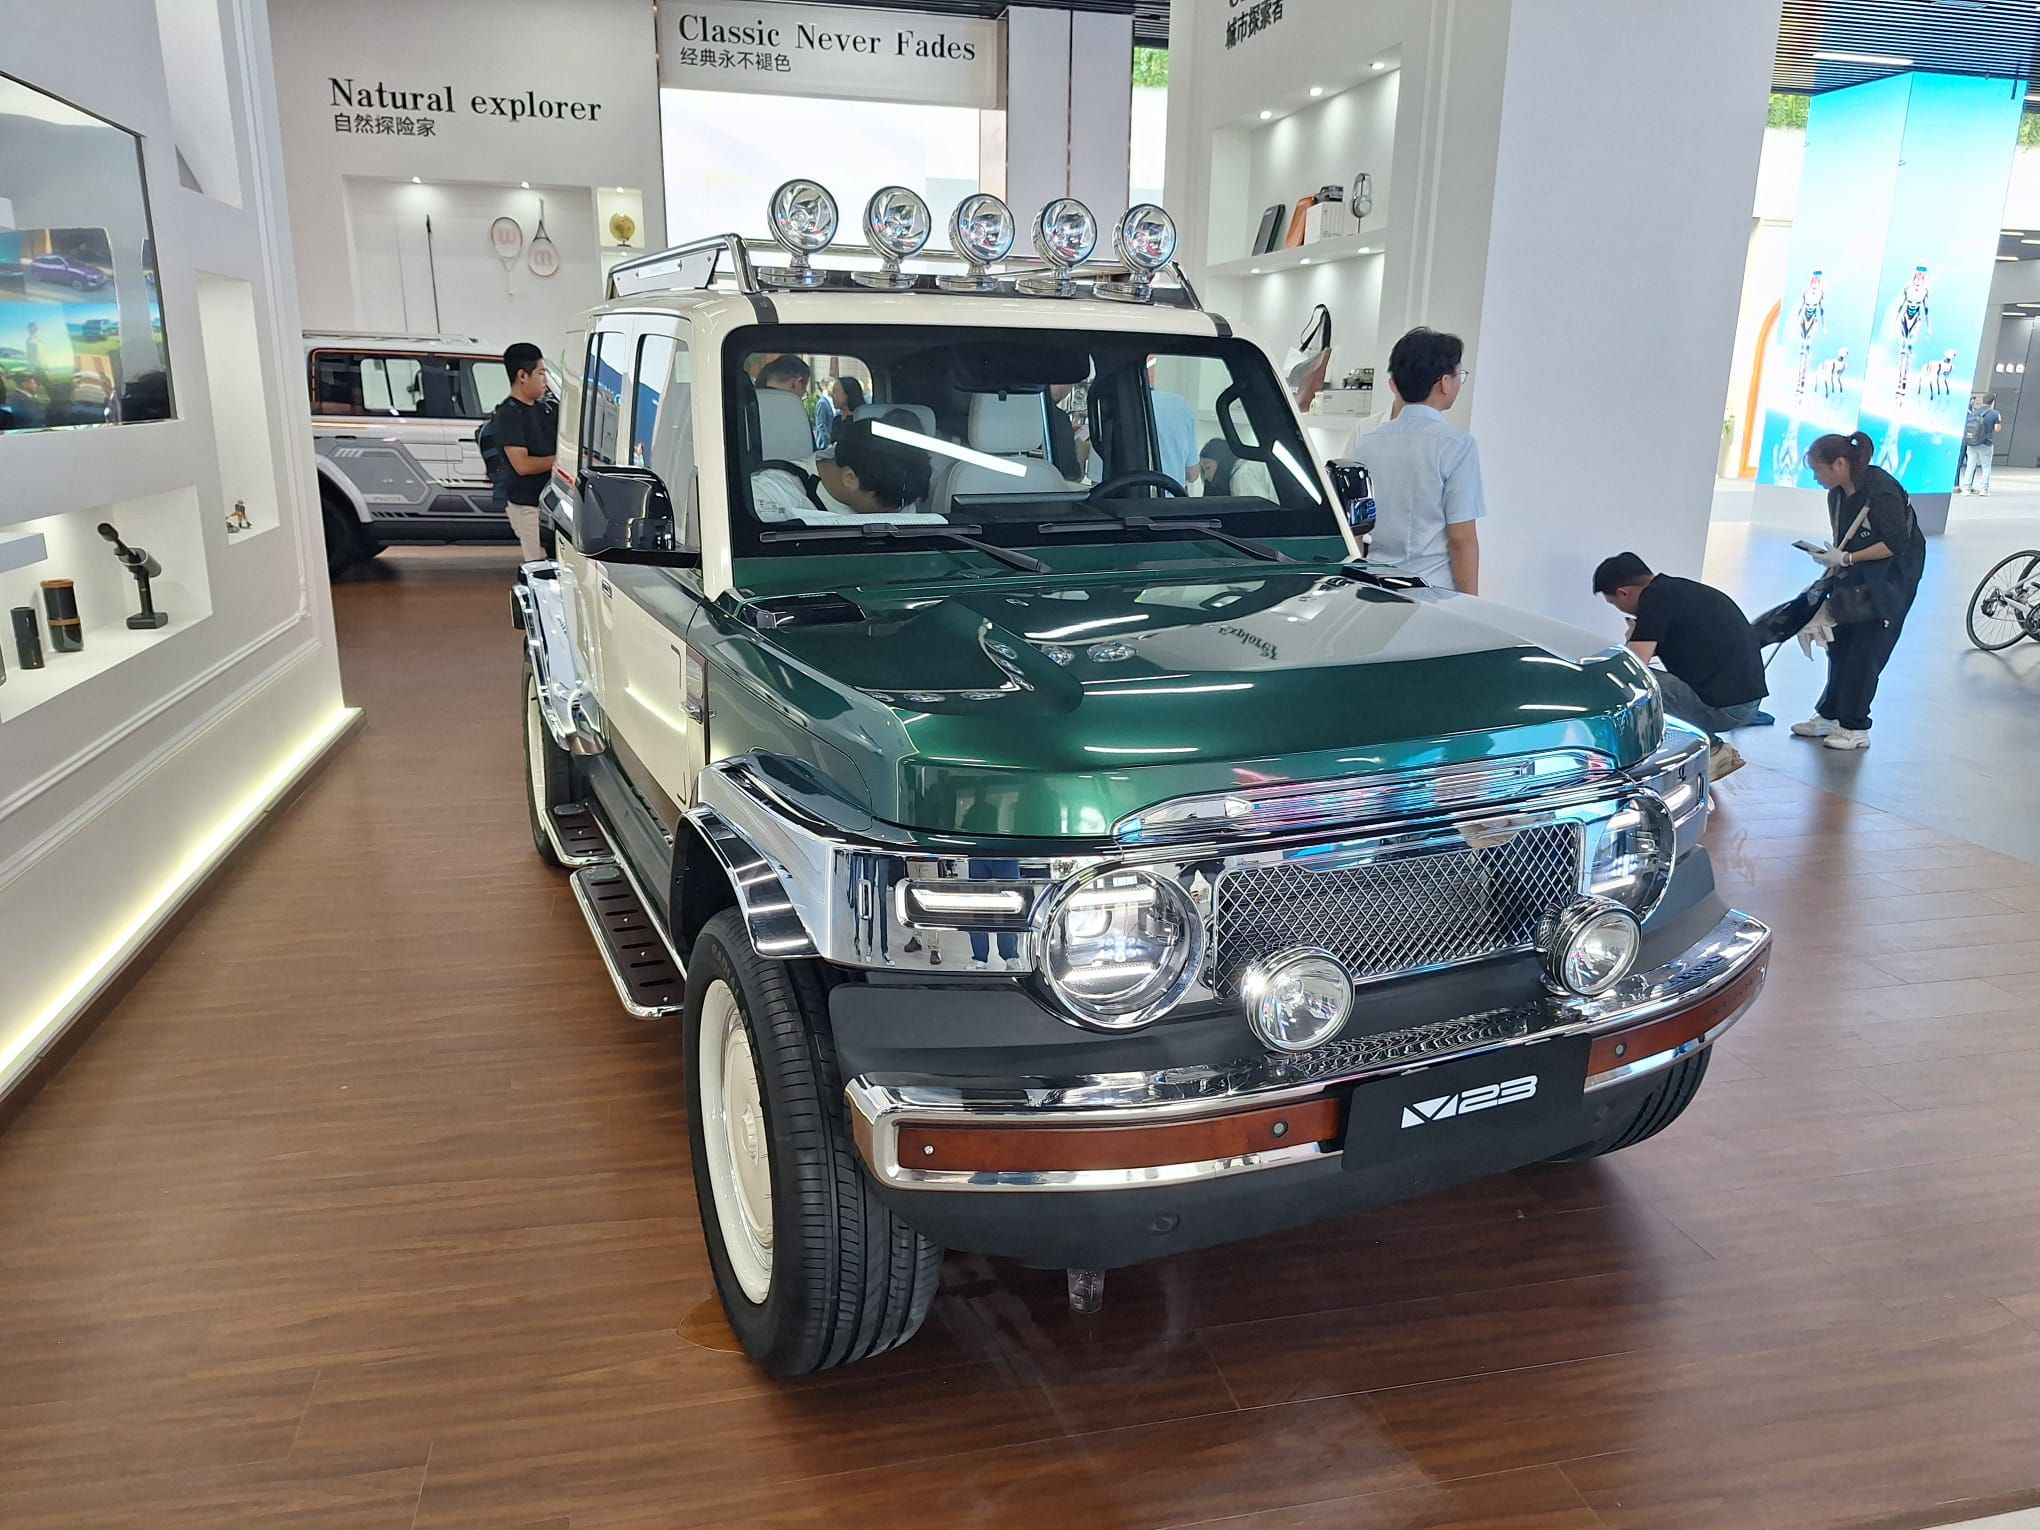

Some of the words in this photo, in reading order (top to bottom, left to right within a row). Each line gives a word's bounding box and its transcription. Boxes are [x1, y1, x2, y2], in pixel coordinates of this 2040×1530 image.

[679, 14, 780, 47] Classic
[795, 23, 881, 54] Never
[895, 30, 976, 61] Fades
[680, 47, 791, 73] 经典永不褪色
[328, 78, 456, 113] Natural
[470, 91, 601, 123] explorer
[334, 113, 436, 137] 自然探险家
